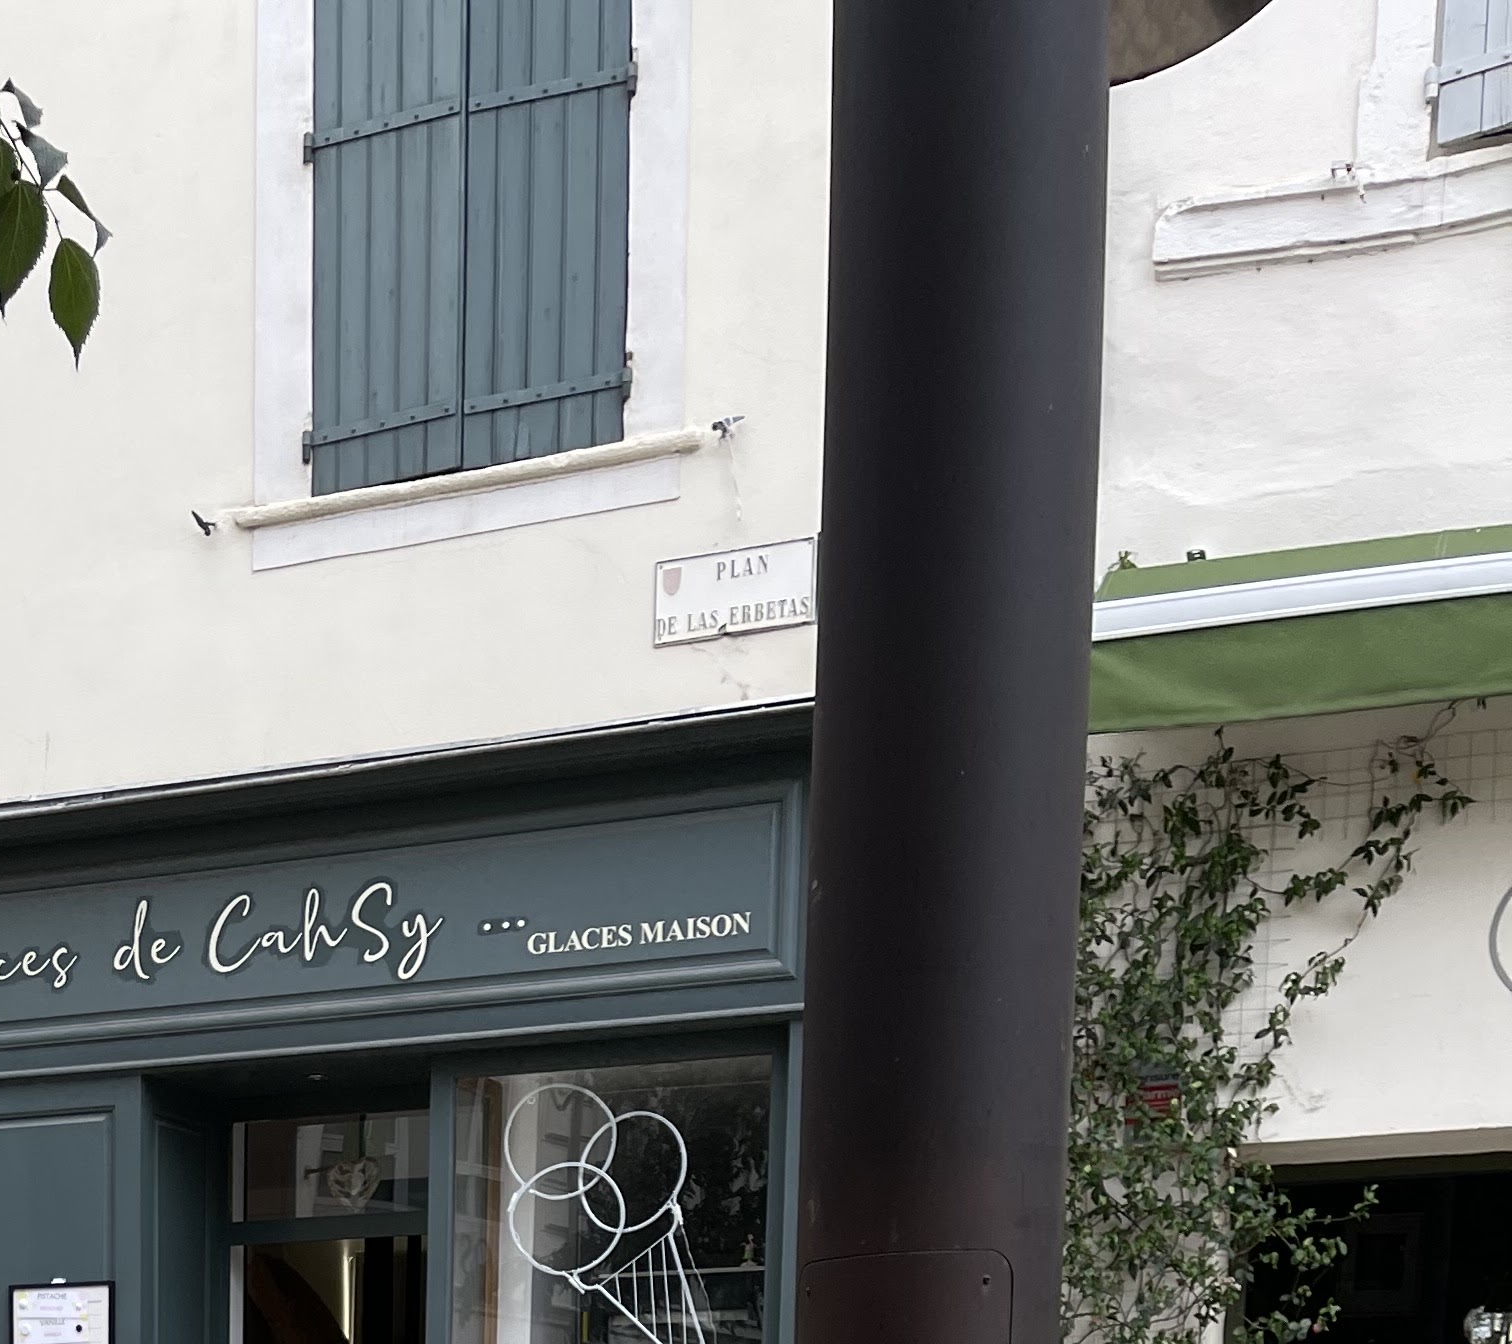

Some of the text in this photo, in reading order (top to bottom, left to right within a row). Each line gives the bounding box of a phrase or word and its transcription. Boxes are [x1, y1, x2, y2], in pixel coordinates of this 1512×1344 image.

[716, 554, 770, 581] PLAN
[657, 597, 810, 639] DE LAS ERBETAS
[113, 900, 182, 980] de
[208, 882, 444, 981] CahSy
[527, 911, 751, 956] GLACES MAISON
